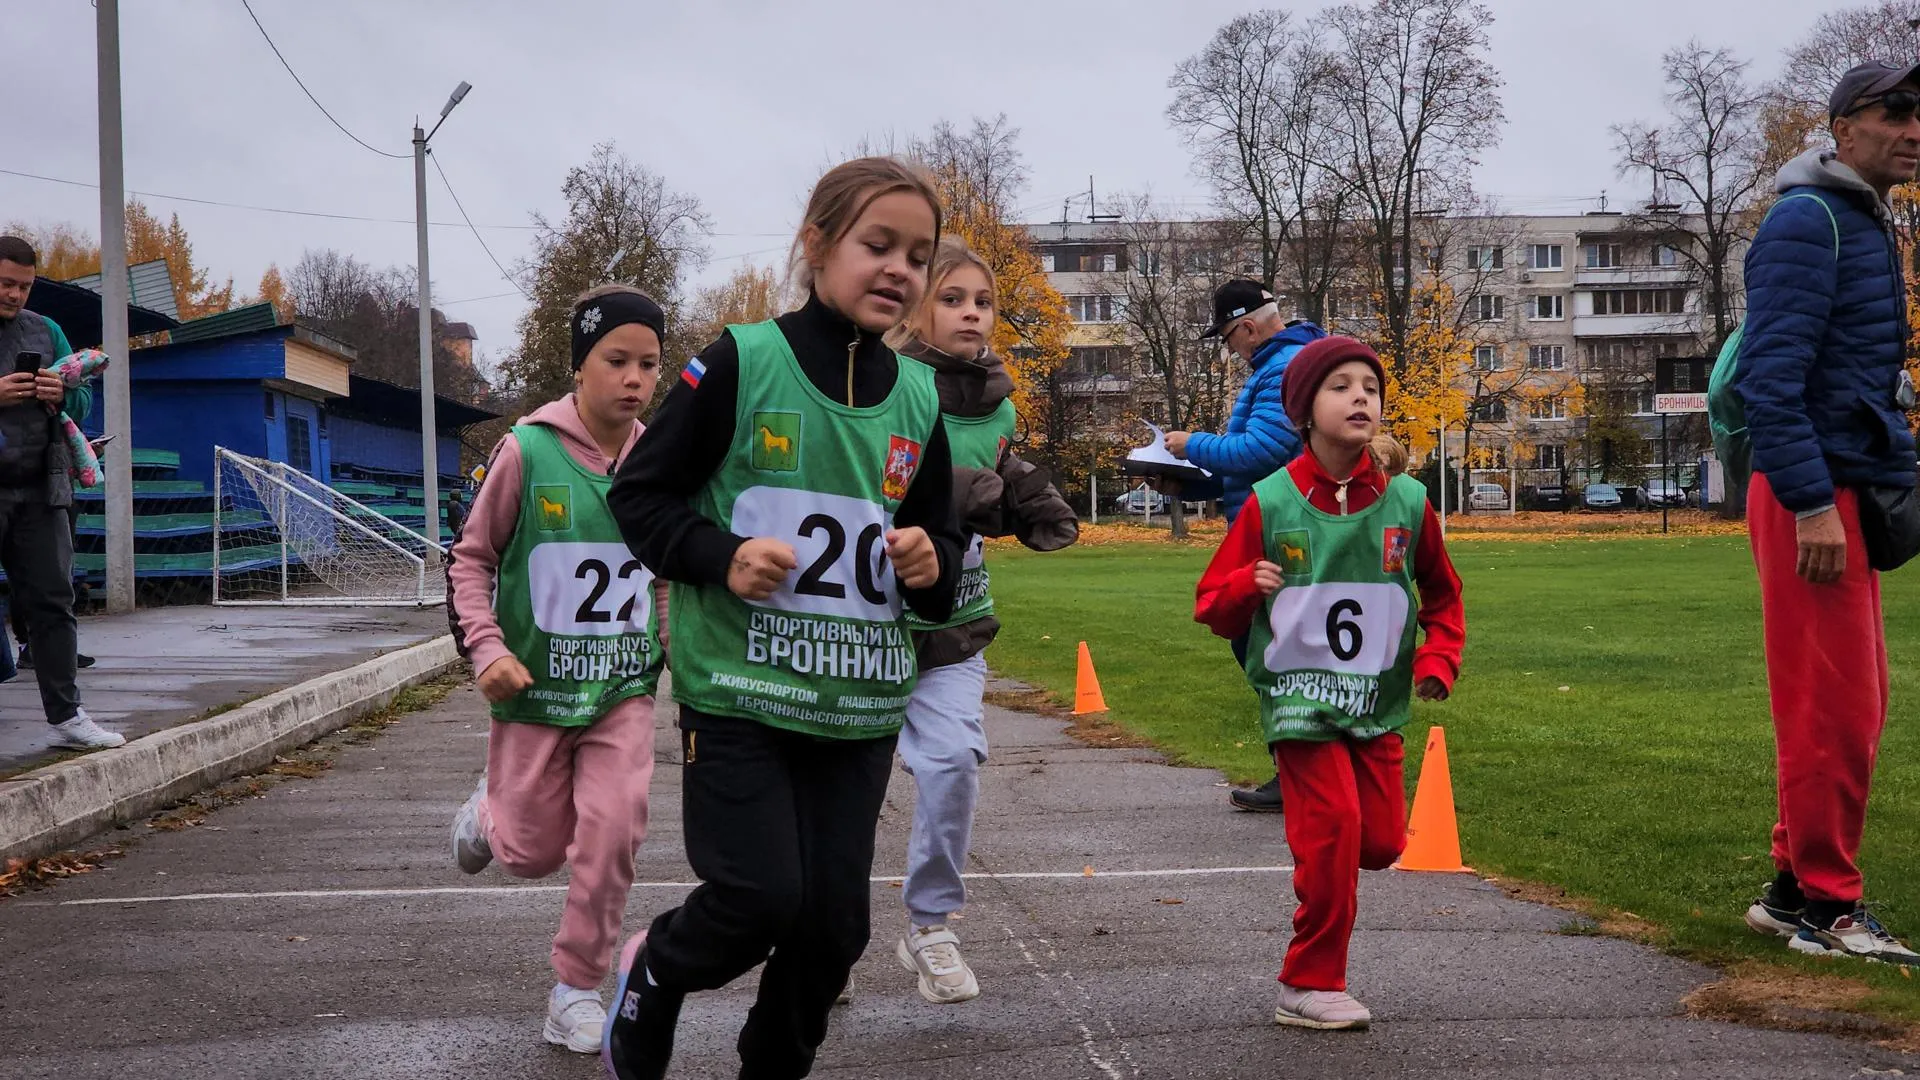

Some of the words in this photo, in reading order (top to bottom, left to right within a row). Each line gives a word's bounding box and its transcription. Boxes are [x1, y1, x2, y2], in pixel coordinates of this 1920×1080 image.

[793, 513, 888, 606] 20
[574, 558, 643, 623] 22
[746, 629, 913, 685] БРОННИЦЫ
[750, 610, 882, 646] СПОРТИВНЫЙ
[1326, 598, 1363, 661] 6
[711, 671, 818, 703] #ЖИВУСПОРТОМ
